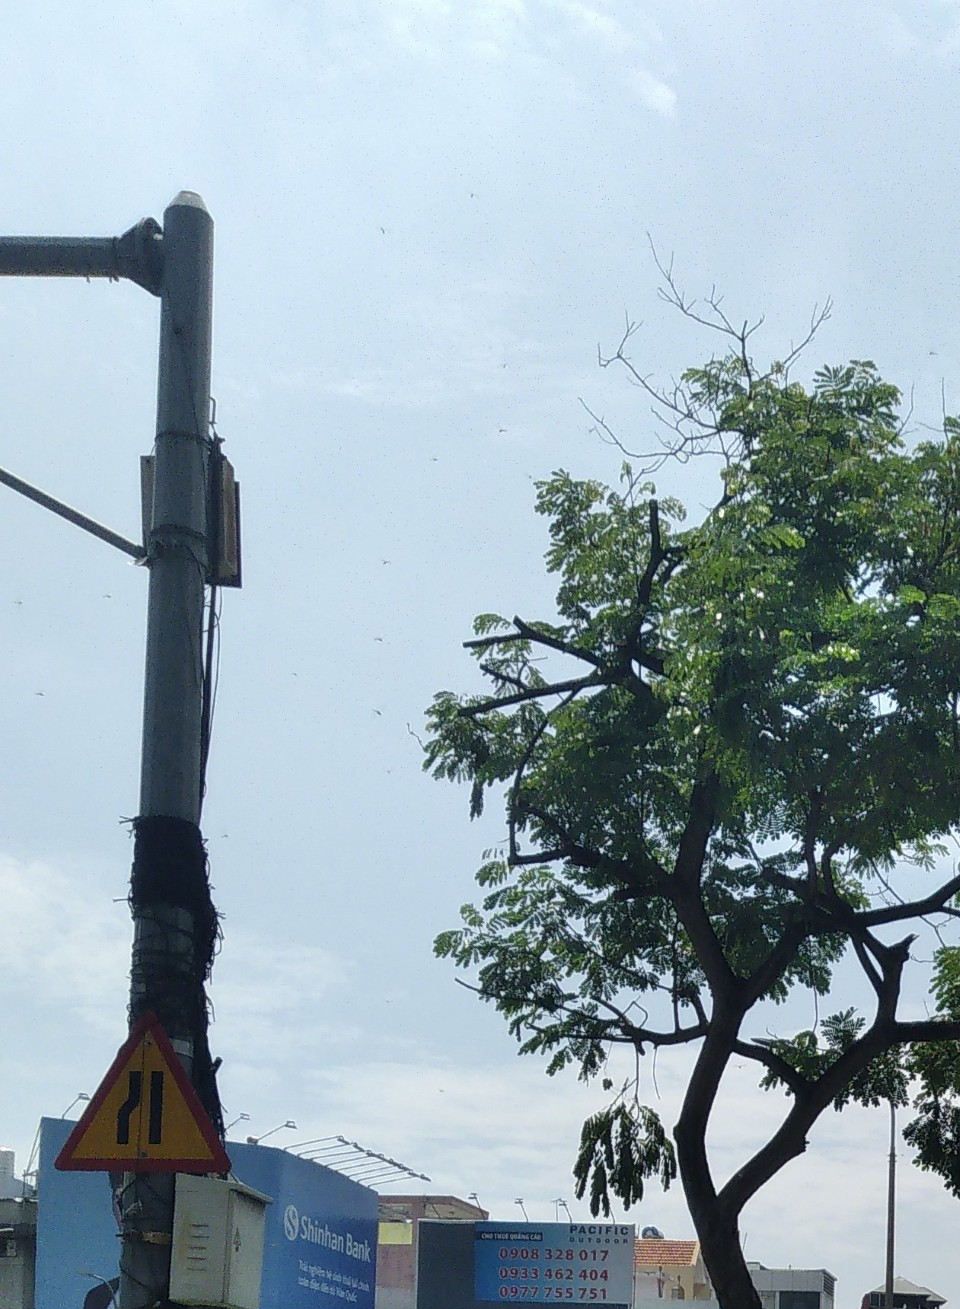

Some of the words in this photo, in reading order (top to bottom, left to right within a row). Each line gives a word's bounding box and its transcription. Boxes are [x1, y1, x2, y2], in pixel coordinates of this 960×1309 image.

[569, 1225, 629, 1236] PACIFIC
[300, 1215, 344, 1254] Shinhan
[345, 1232, 371, 1263] Bank
[499, 1248, 540, 1260] 0908
[544, 1249, 574, 1260] 328
[578, 1250, 609, 1261] 017
[499, 1267, 540, 1279] 0933
[544, 1268, 574, 1280] 462
[578, 1269, 609, 1281] 404
[499, 1286, 540, 1297] 0977
[544, 1287, 574, 1299] 755
[578, 1288, 608, 1300] 751
